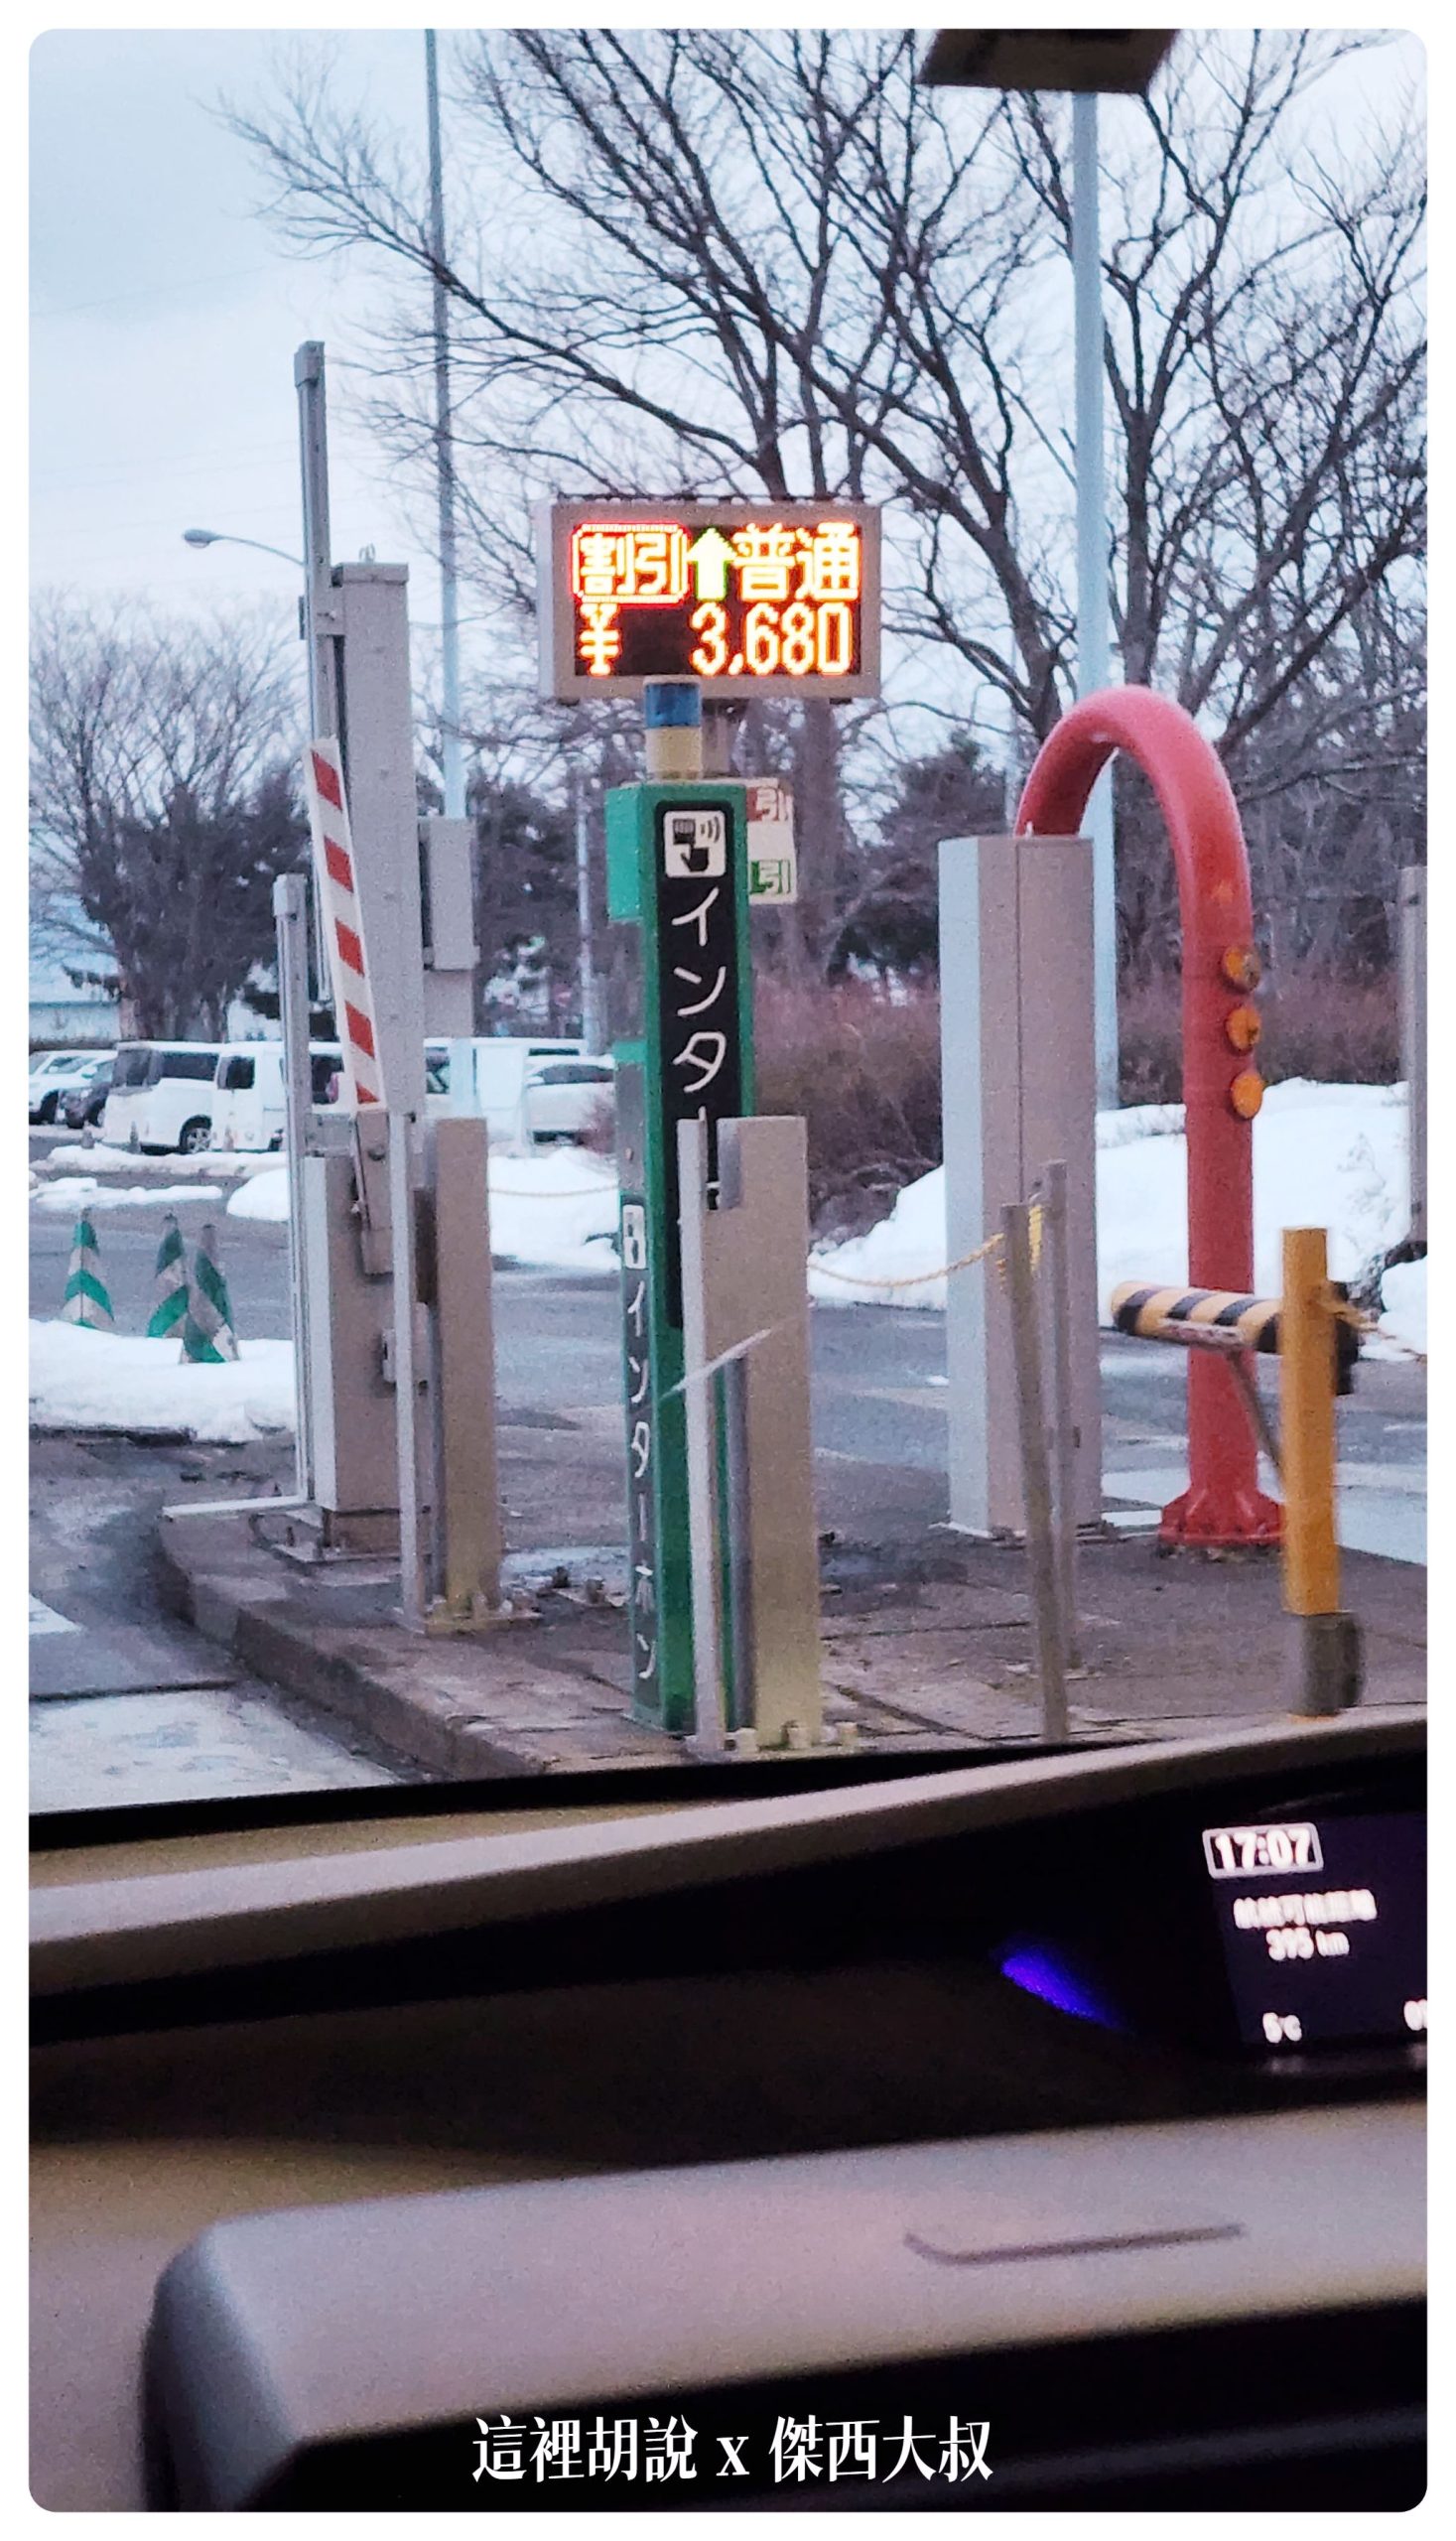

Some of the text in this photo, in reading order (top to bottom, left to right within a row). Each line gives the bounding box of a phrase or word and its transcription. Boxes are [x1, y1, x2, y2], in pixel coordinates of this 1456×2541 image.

[579, 523, 860, 601] 割引 普通
[691, 602, 852, 676] 3,680
[627, 1280, 657, 1679] インターホン
[1215, 1828, 1311, 1872] 17:07
